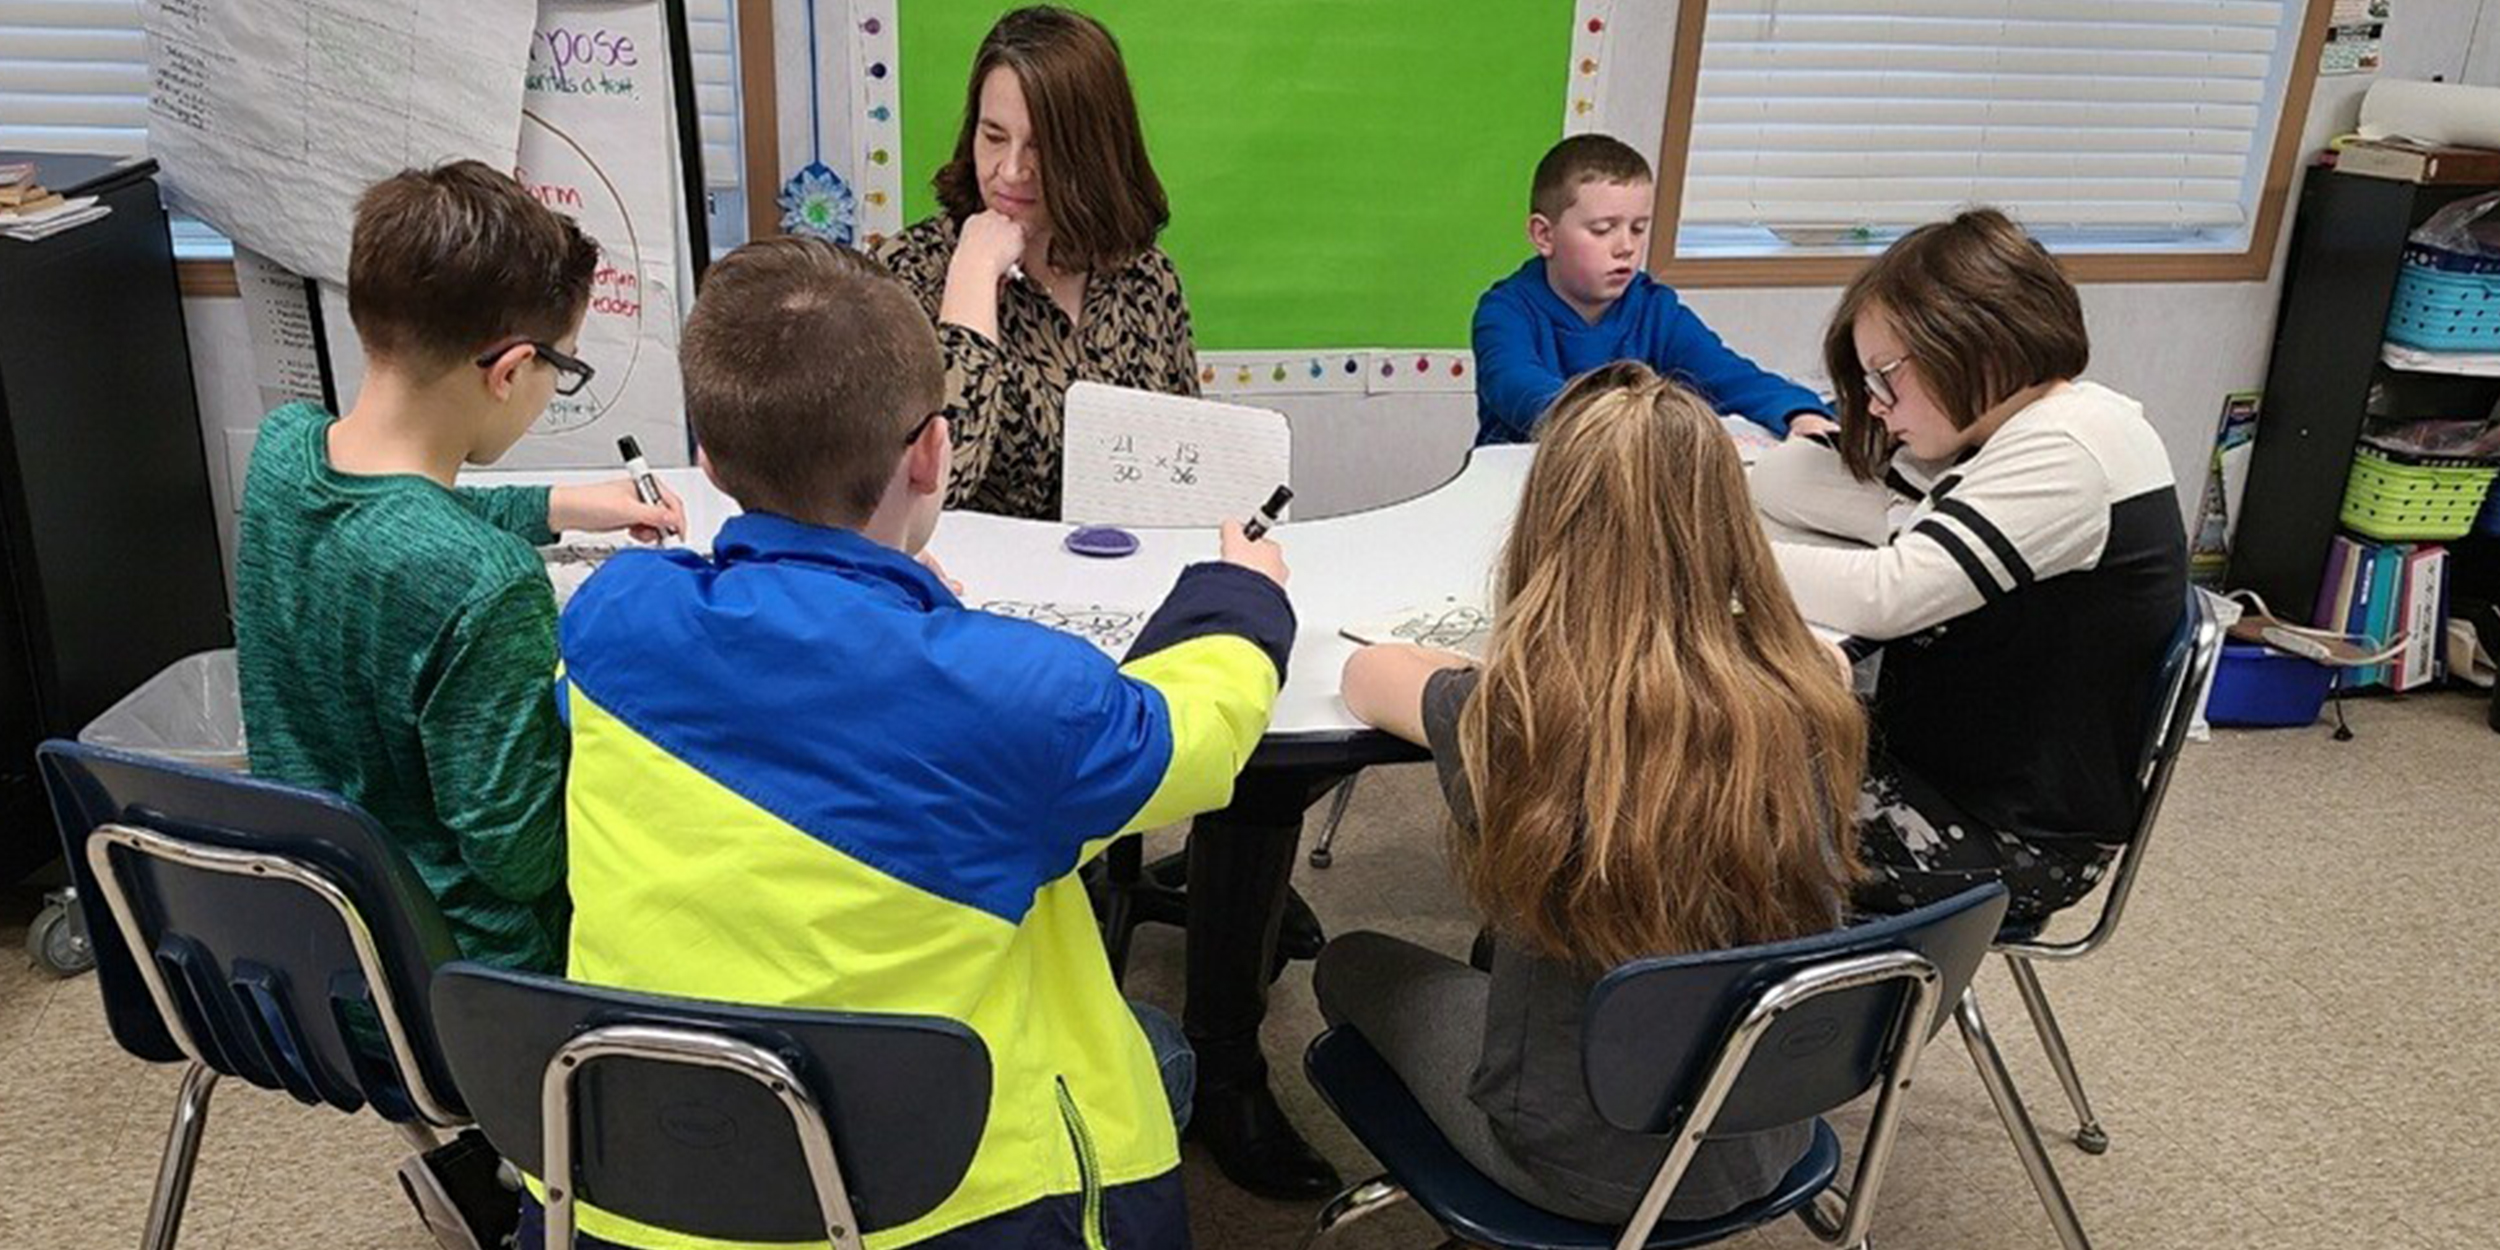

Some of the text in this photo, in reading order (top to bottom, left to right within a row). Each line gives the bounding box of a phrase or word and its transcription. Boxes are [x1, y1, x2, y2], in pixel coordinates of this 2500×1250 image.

[1112, 435, 1133, 453] 21
[1173, 441, 1199, 465] 15
[1112, 463, 1198, 485] 30 36
